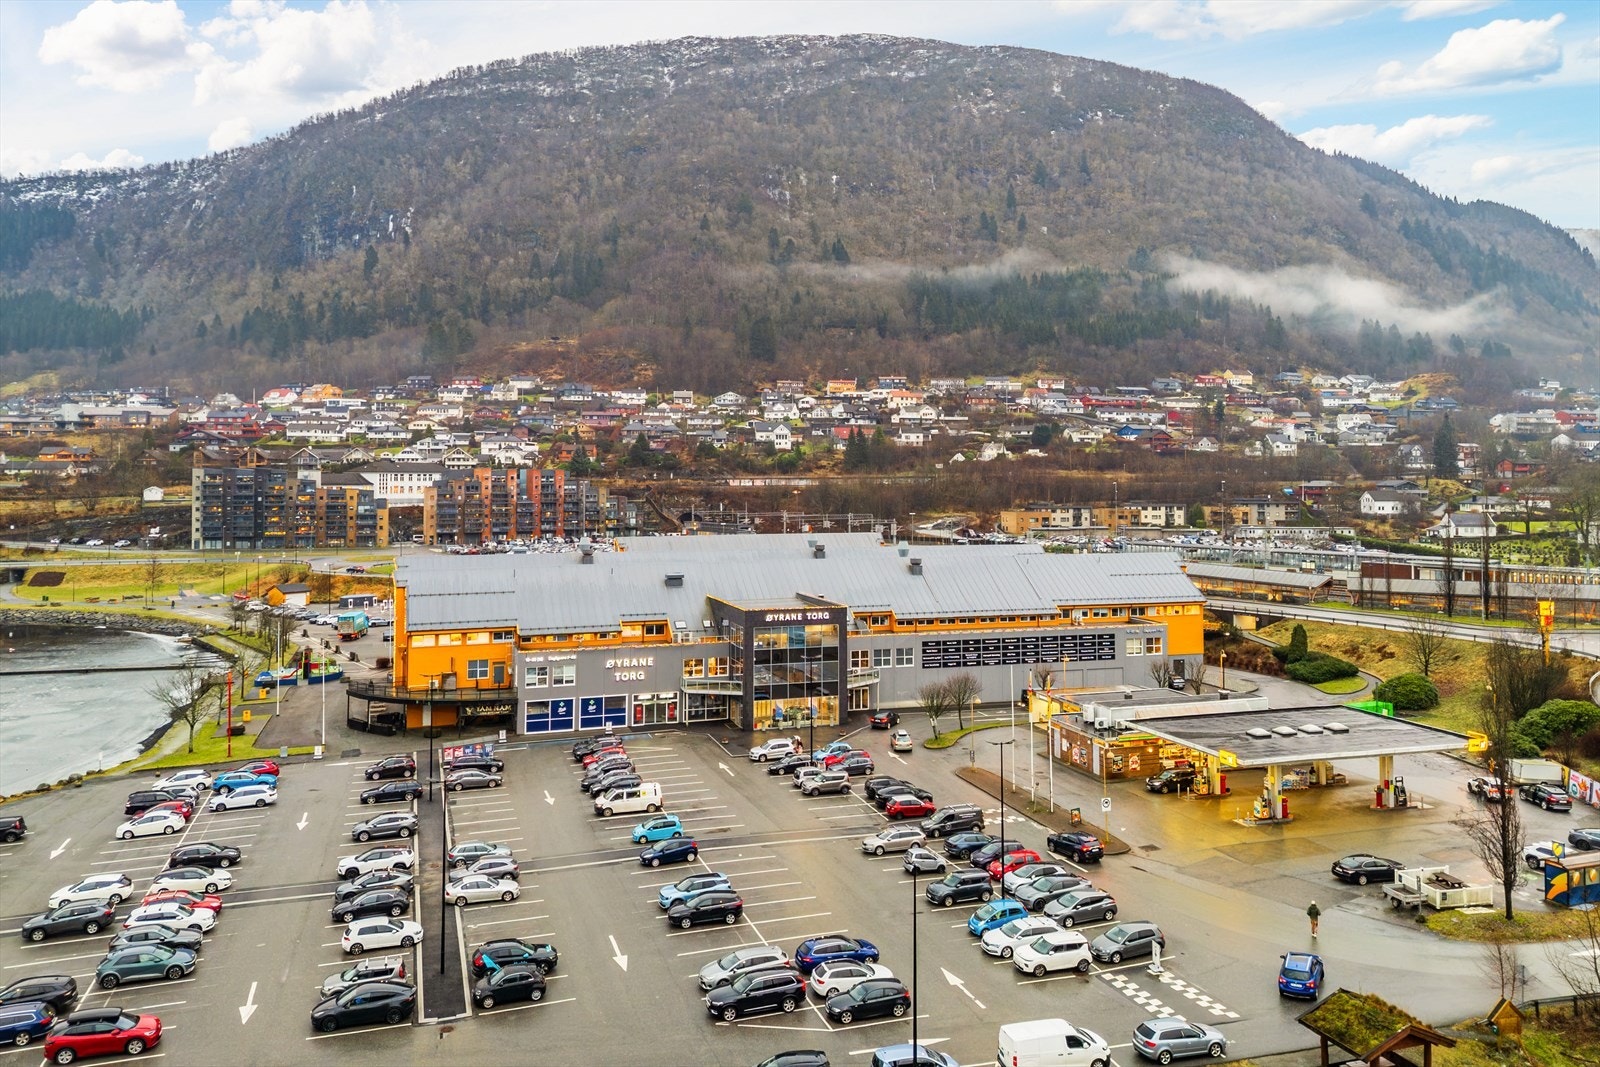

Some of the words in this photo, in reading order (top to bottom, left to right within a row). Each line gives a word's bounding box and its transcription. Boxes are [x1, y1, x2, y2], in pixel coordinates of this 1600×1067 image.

[765, 613, 803, 622] ØYRANE
[806, 612, 830, 620] TORG
[605, 657, 654, 669] ØYRANE
[614, 670, 645, 682] TORG
